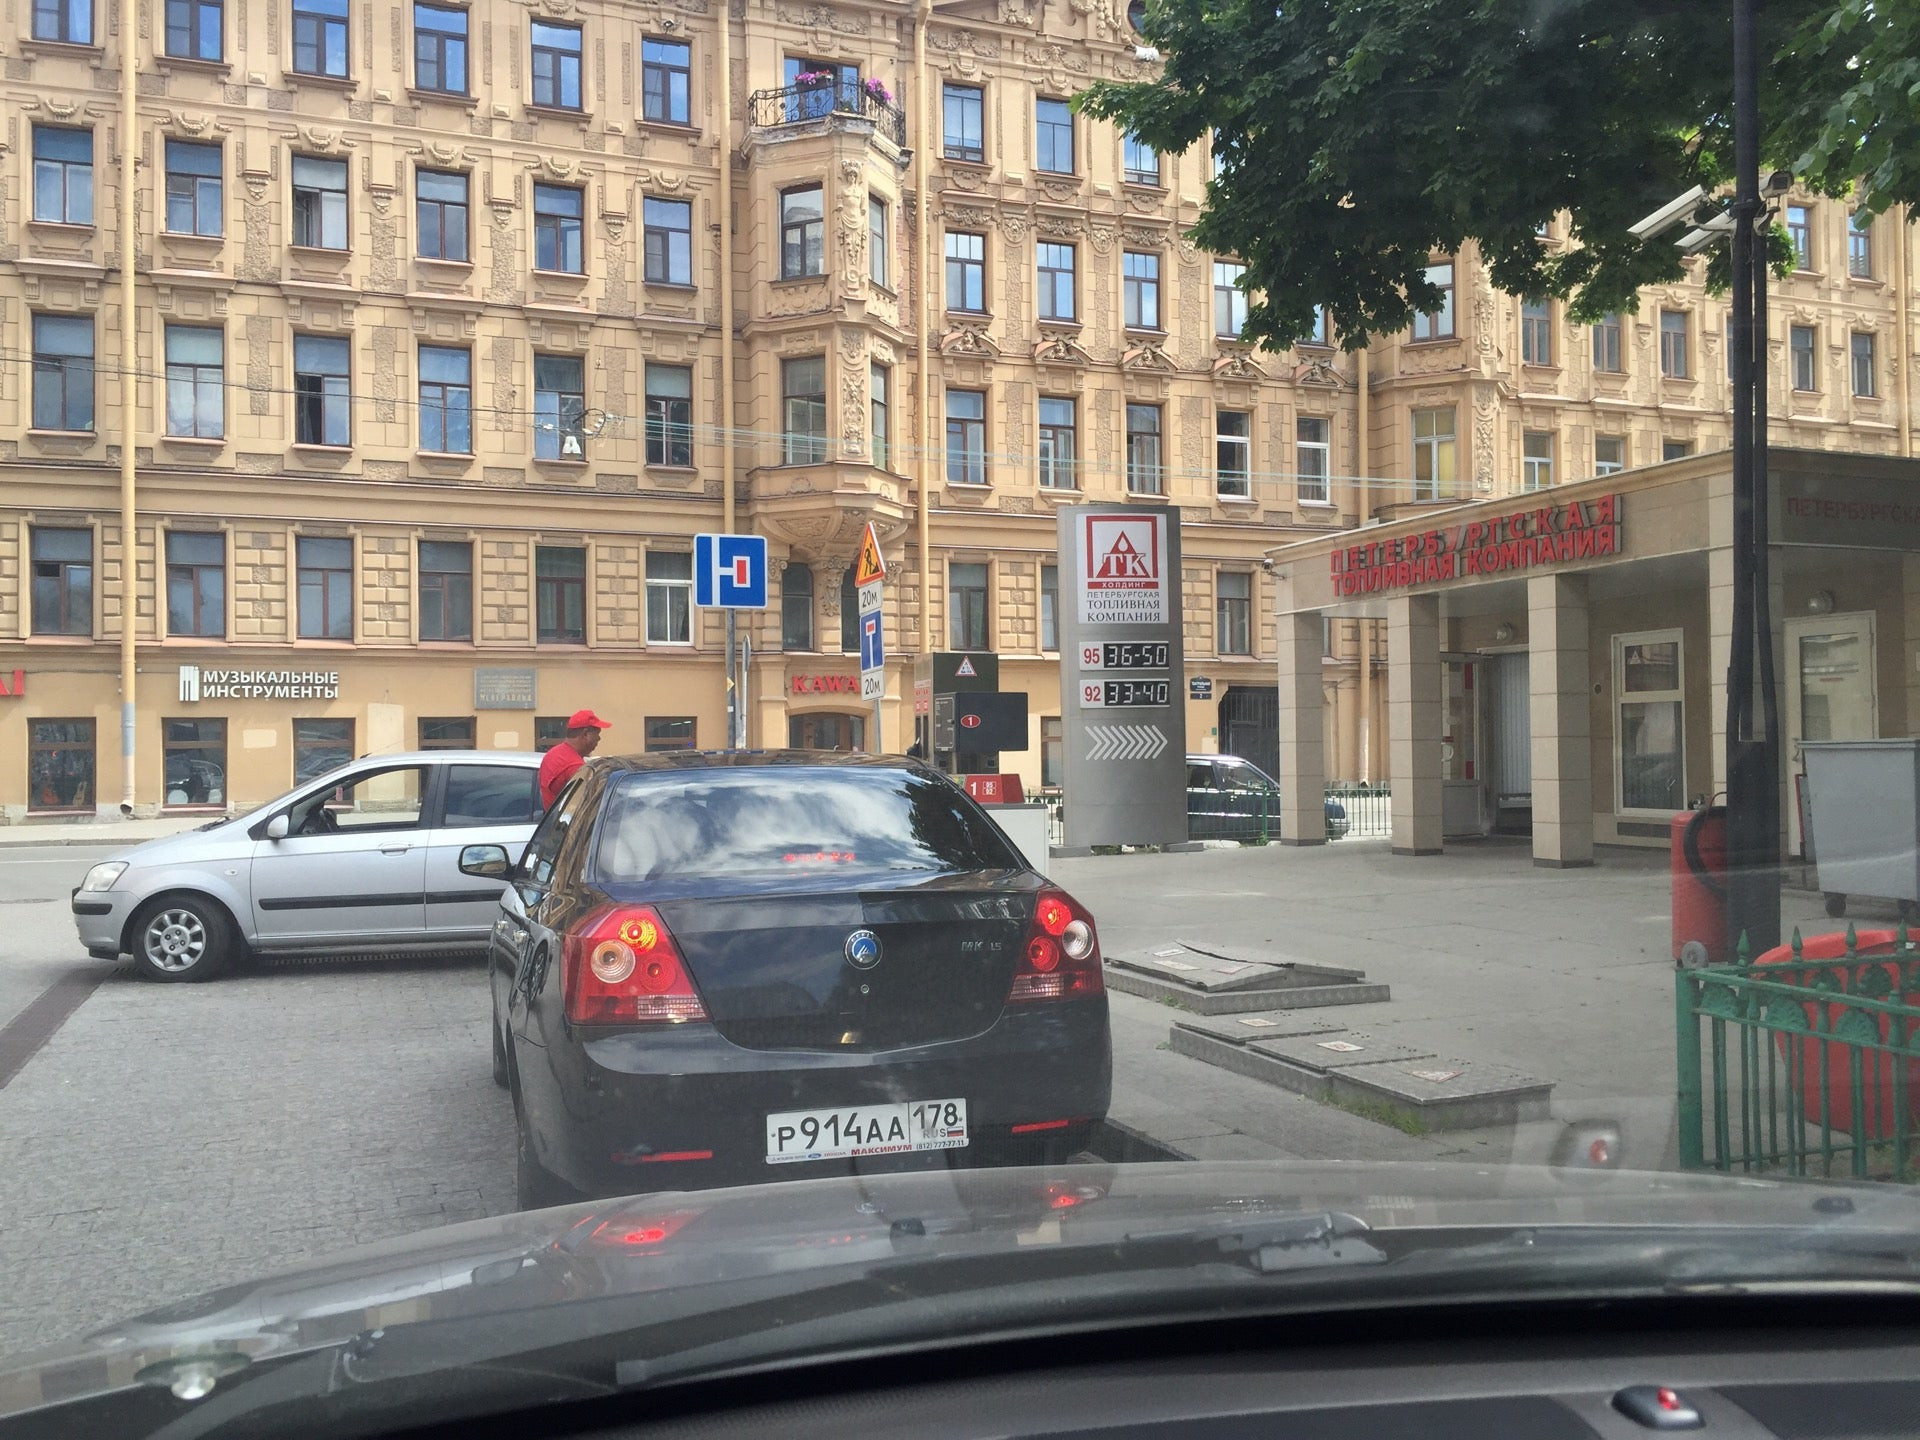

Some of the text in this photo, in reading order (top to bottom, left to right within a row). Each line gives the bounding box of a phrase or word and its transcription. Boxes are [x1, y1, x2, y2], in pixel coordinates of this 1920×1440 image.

[1331, 495, 1618, 572] ПЕТЕРБУРГСКАЯ
[1331, 524, 1621, 597] ТОПЛИВНАЯ КОМПАНИЯ
[1101, 581, 1146, 589] ХОЛДИНГ
[1087, 591, 1160, 599] ПЕТЕРБУРГСКАЯ
[1087, 599, 1160, 610] ТОПЛИВНАЯ
[1087, 611, 1160, 622] КОМПАНИЯ
[1083, 645, 1167, 666] 95 36-50
[202, 670, 339, 684] МУЗЫКАЛЬНЫЕ
[202, 685, 339, 699] ИНСТРУМЕНТЫ
[1084, 683, 1168, 704] 92 33-40
[967, 716, 974, 726] 1
[970, 781, 977, 795] 1
[778, 1102, 959, 1152] Р914АА 178
[923, 1129, 946, 1139] RUS
[850, 1144, 913, 1156] МАКСИМУМ
